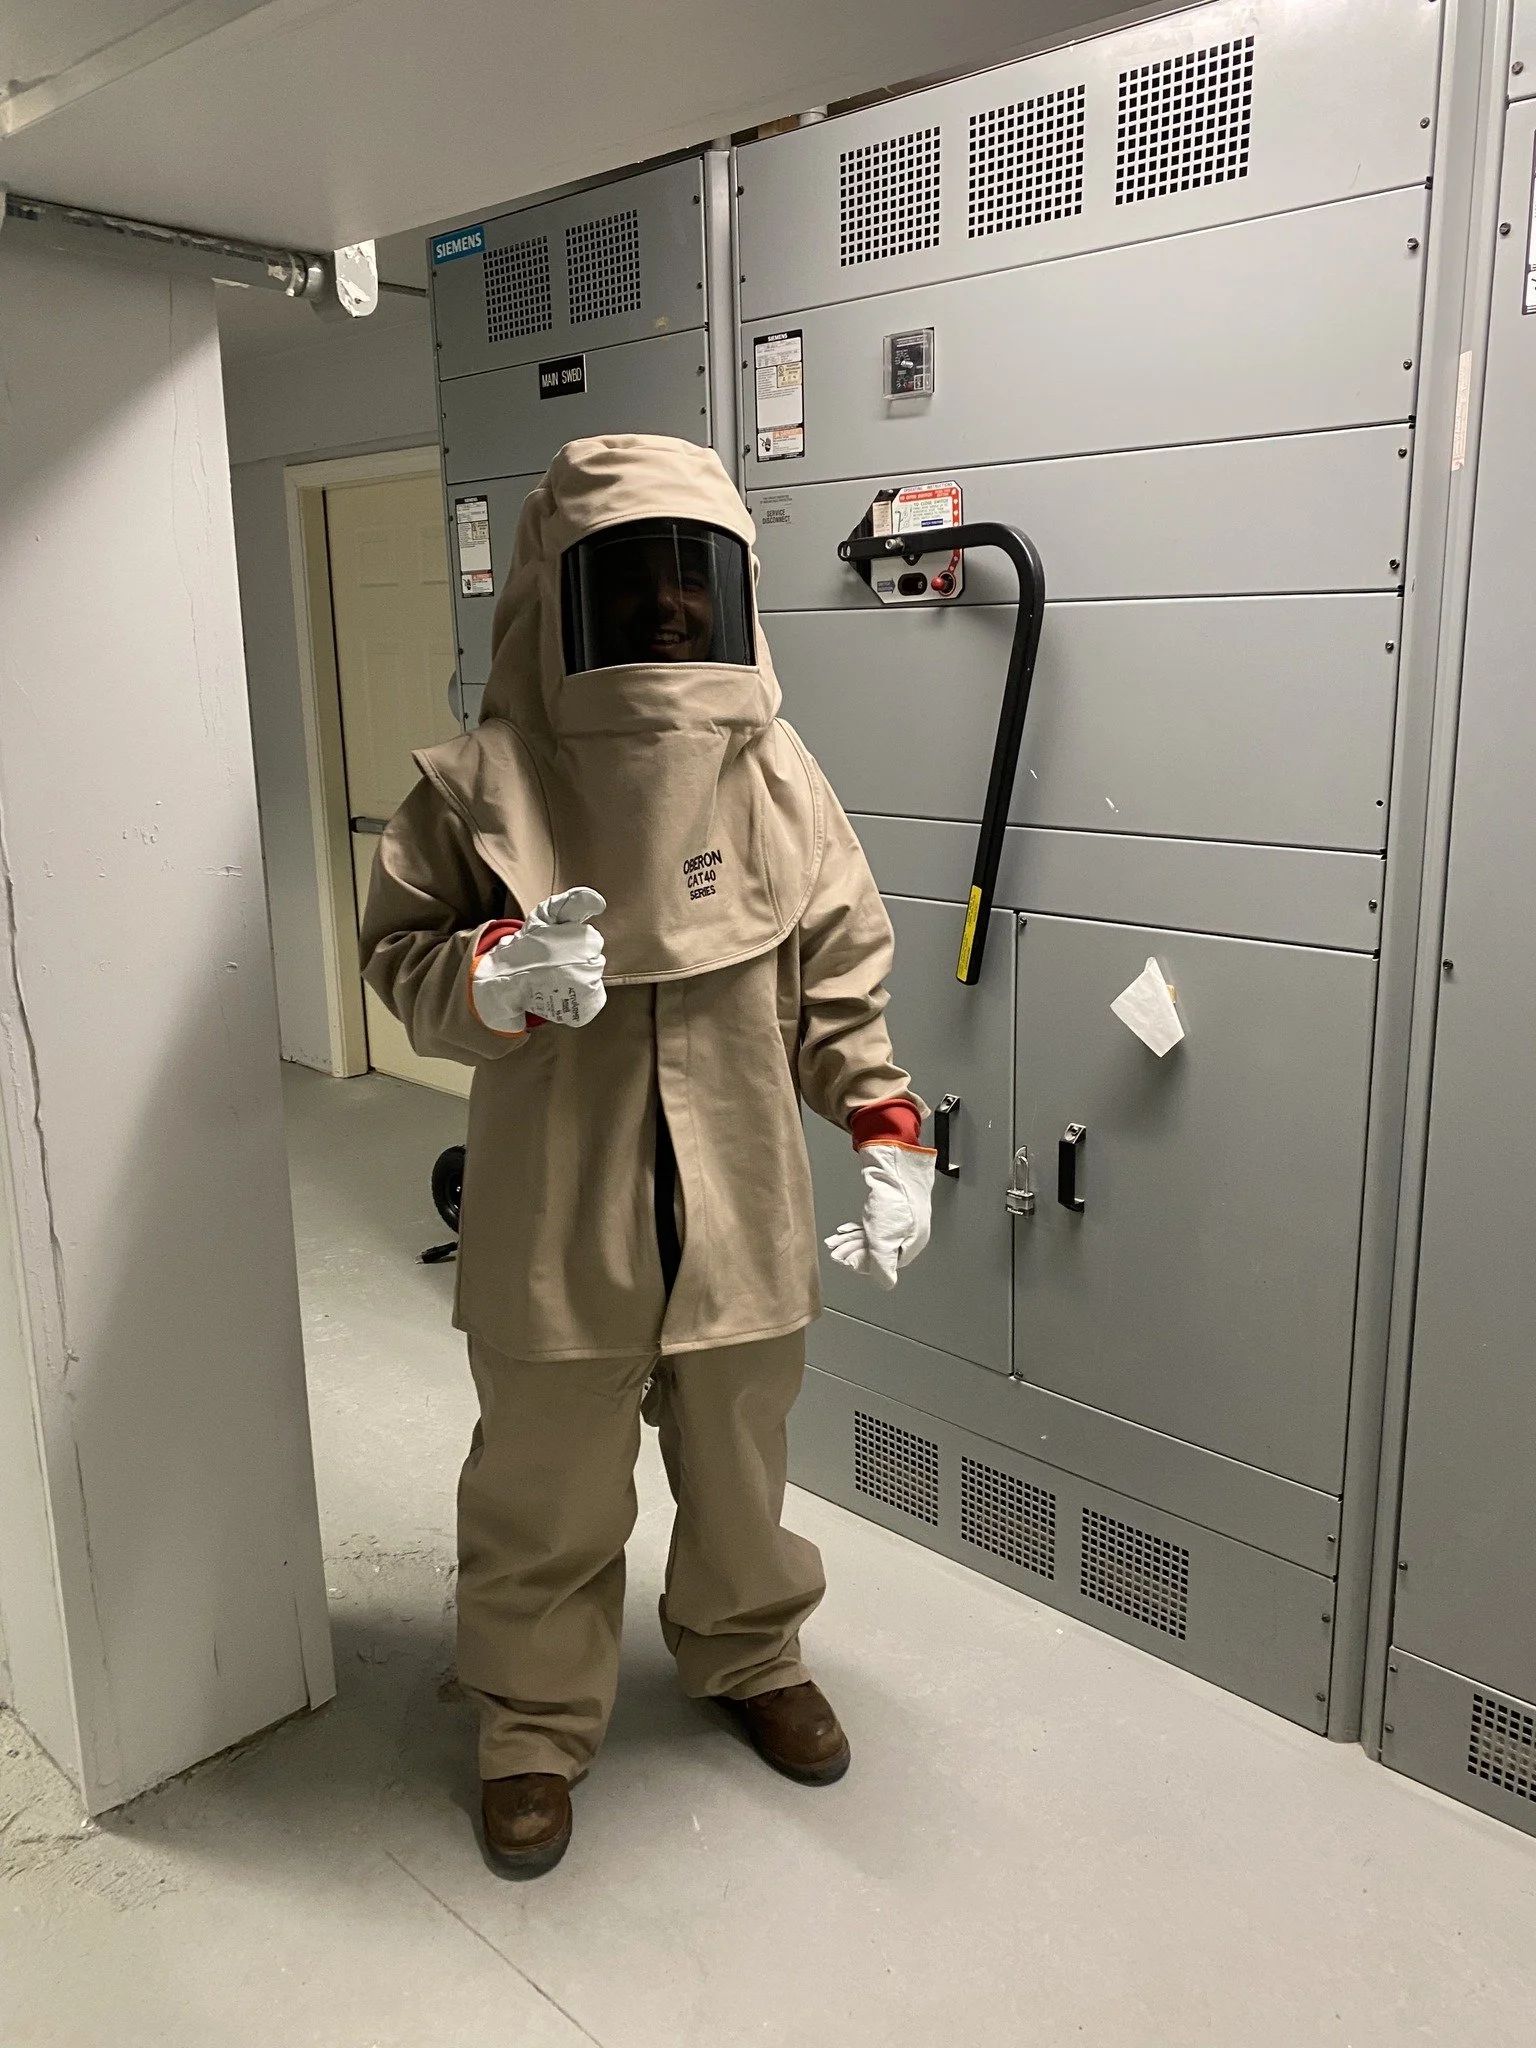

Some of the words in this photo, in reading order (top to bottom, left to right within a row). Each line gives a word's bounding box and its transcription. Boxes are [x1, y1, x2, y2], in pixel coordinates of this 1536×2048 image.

[436, 232, 482, 258] SIEMENS
[541, 372, 559, 388] MAIN
[561, 367, 582, 384] SWBD
[766, 508, 786, 518] SERVICE
[683, 850, 722, 874] OBERON
[690, 885, 716, 901] SERIES
